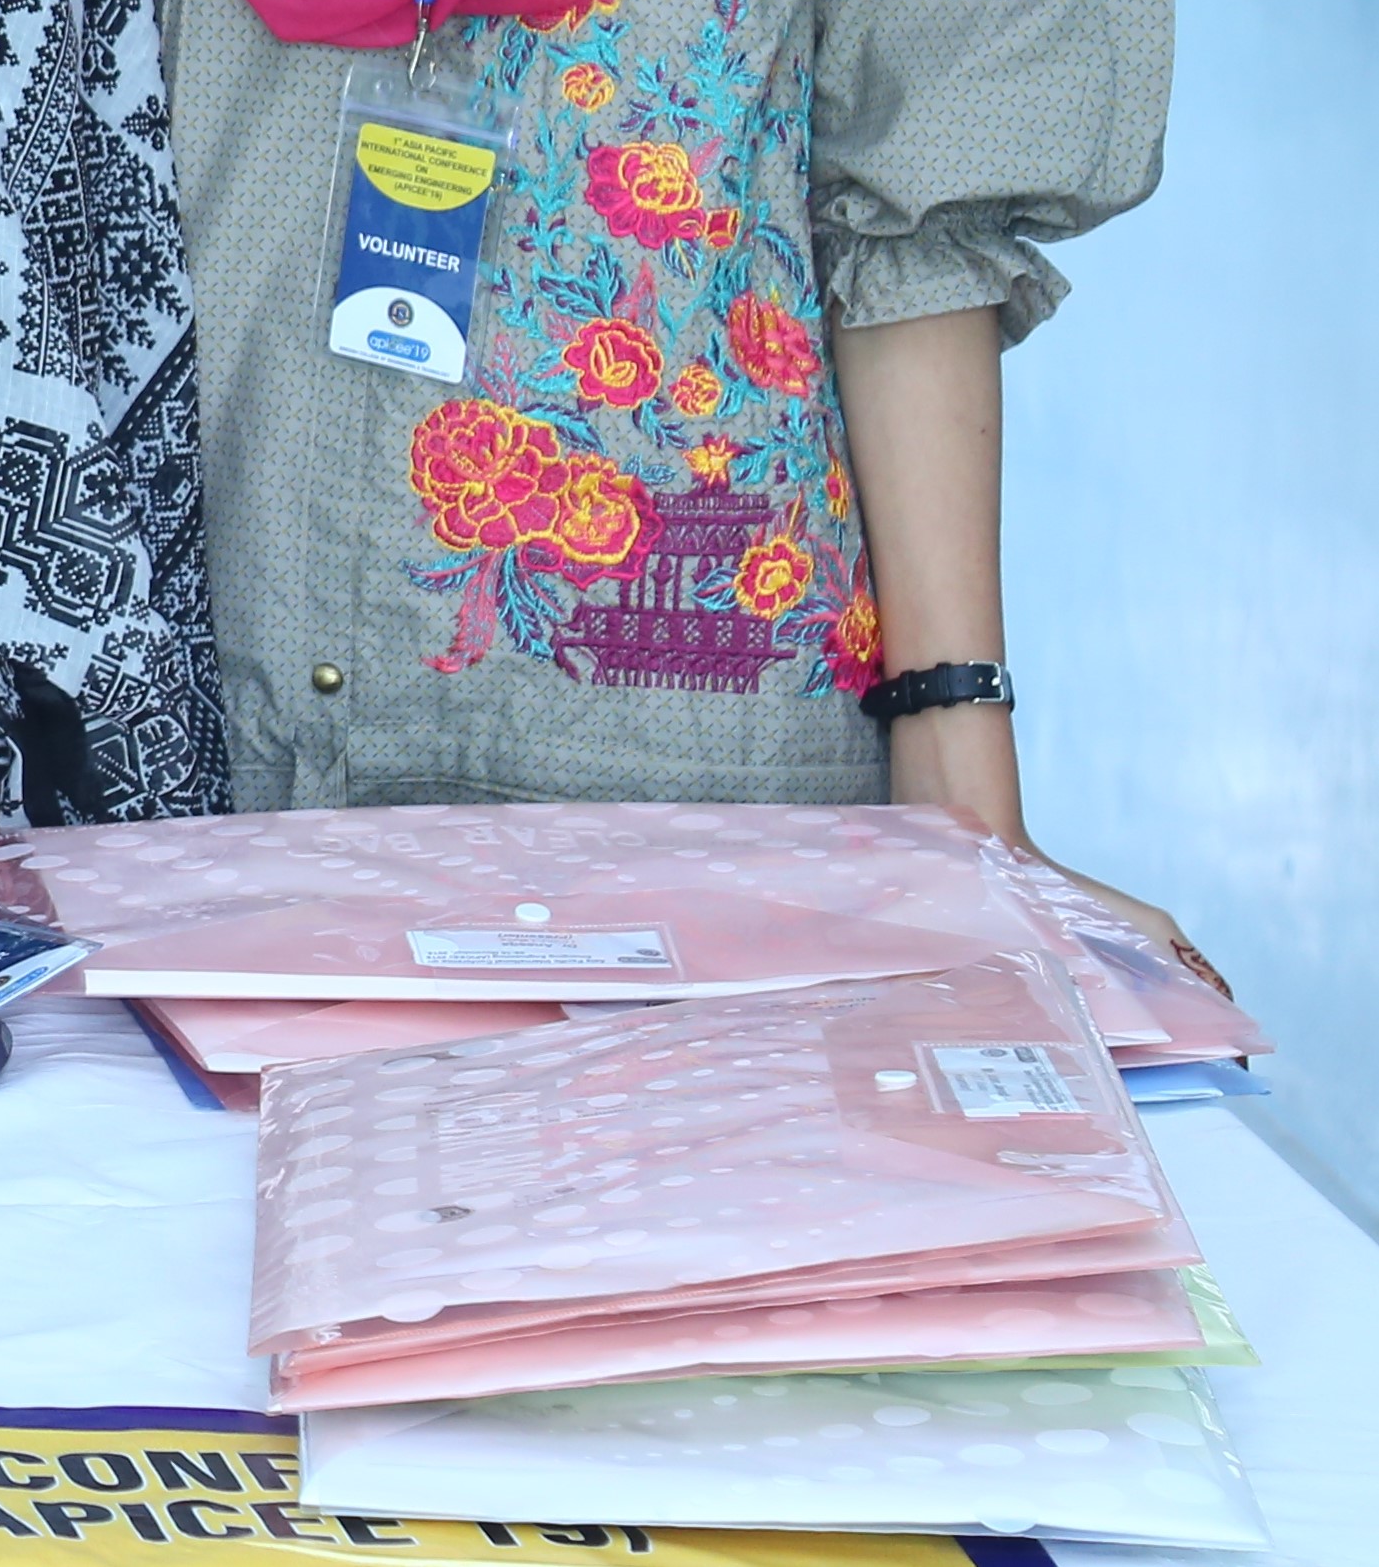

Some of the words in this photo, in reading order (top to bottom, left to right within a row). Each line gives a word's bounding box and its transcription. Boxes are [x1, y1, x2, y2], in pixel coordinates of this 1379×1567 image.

[361, 140, 427, 164] INTERNATIONAL
[428, 156, 487, 177] CONFERENCE
[403, 139, 424, 151] ASIA
[424, 143, 458, 159] PACIFIC
[368, 164, 413, 182] EMERGING
[414, 175, 472, 196] ENGINEERING
[415, 164, 429, 174] ON
[358, 232, 461, 273] VOLUNTEER
